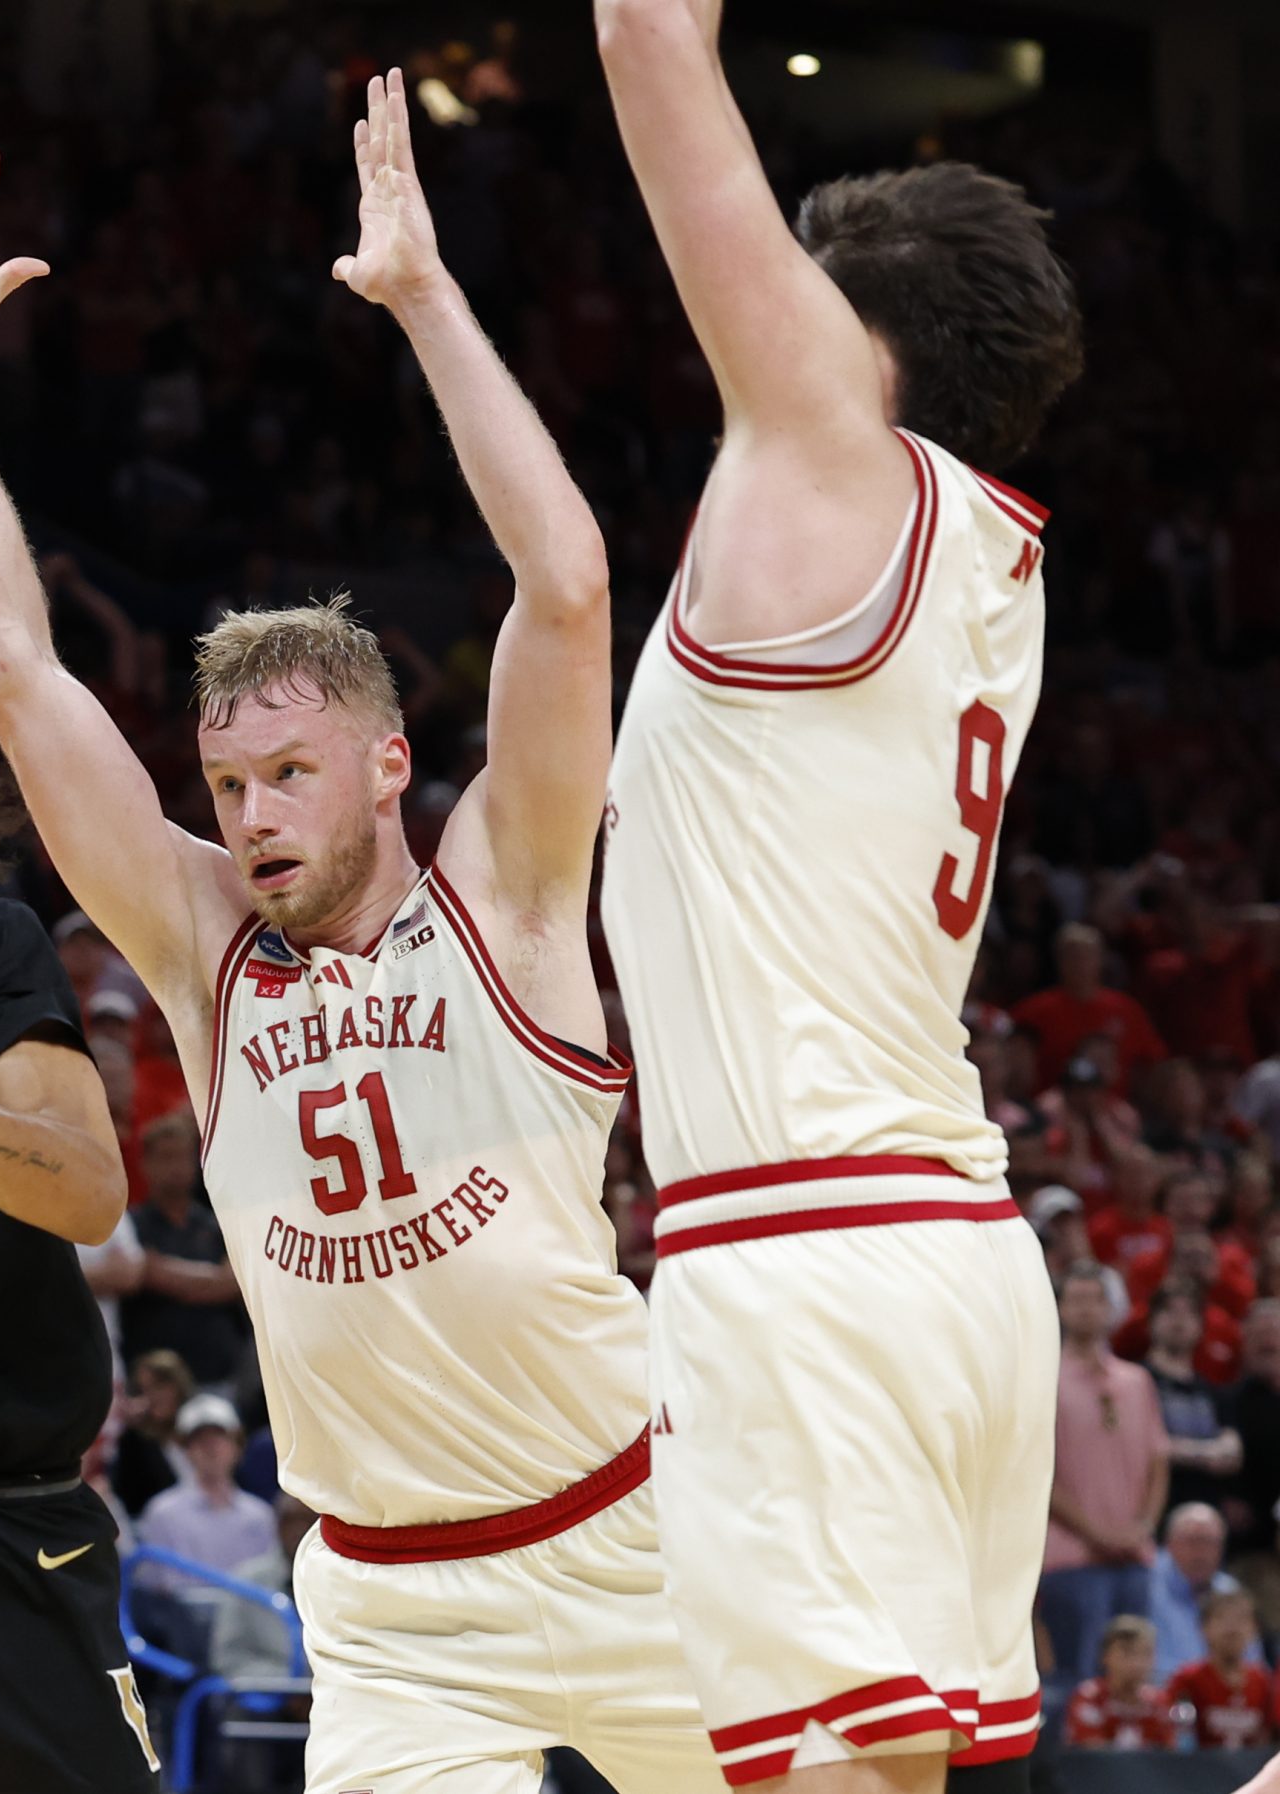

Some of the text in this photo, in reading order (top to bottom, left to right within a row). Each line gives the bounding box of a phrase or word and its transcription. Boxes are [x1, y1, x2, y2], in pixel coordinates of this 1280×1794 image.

[932, 697, 1006, 941] 9
[298, 1071, 418, 1217] 51
[264, 1165, 509, 1285] CORNHUSKERS
